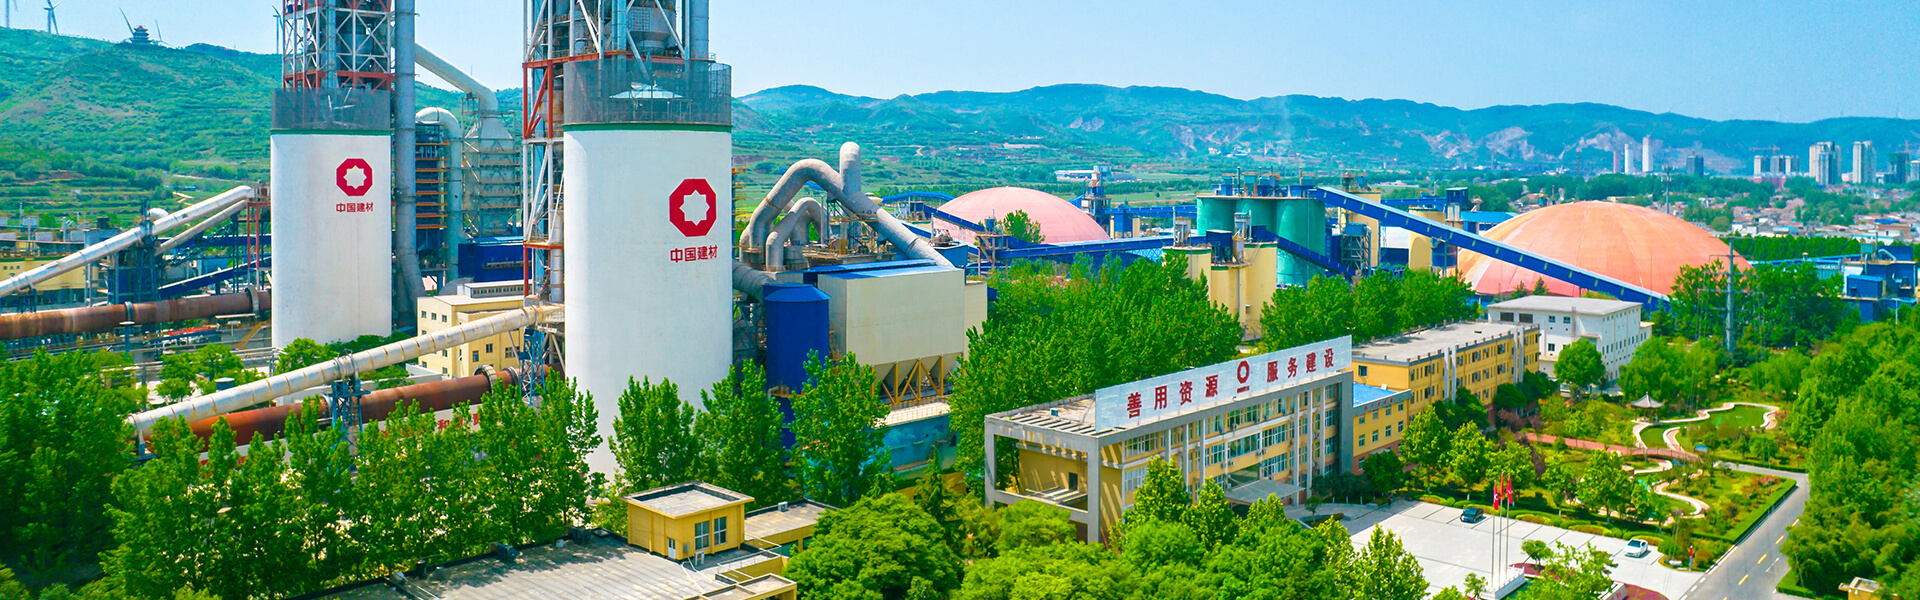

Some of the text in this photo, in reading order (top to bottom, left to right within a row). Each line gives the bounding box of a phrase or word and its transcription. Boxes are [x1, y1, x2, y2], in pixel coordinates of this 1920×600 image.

[336, 201, 374, 213] 中国建材
[670, 244, 718, 263] 中国建材
[1126, 348, 1335, 419] 善用资源 服务建设
